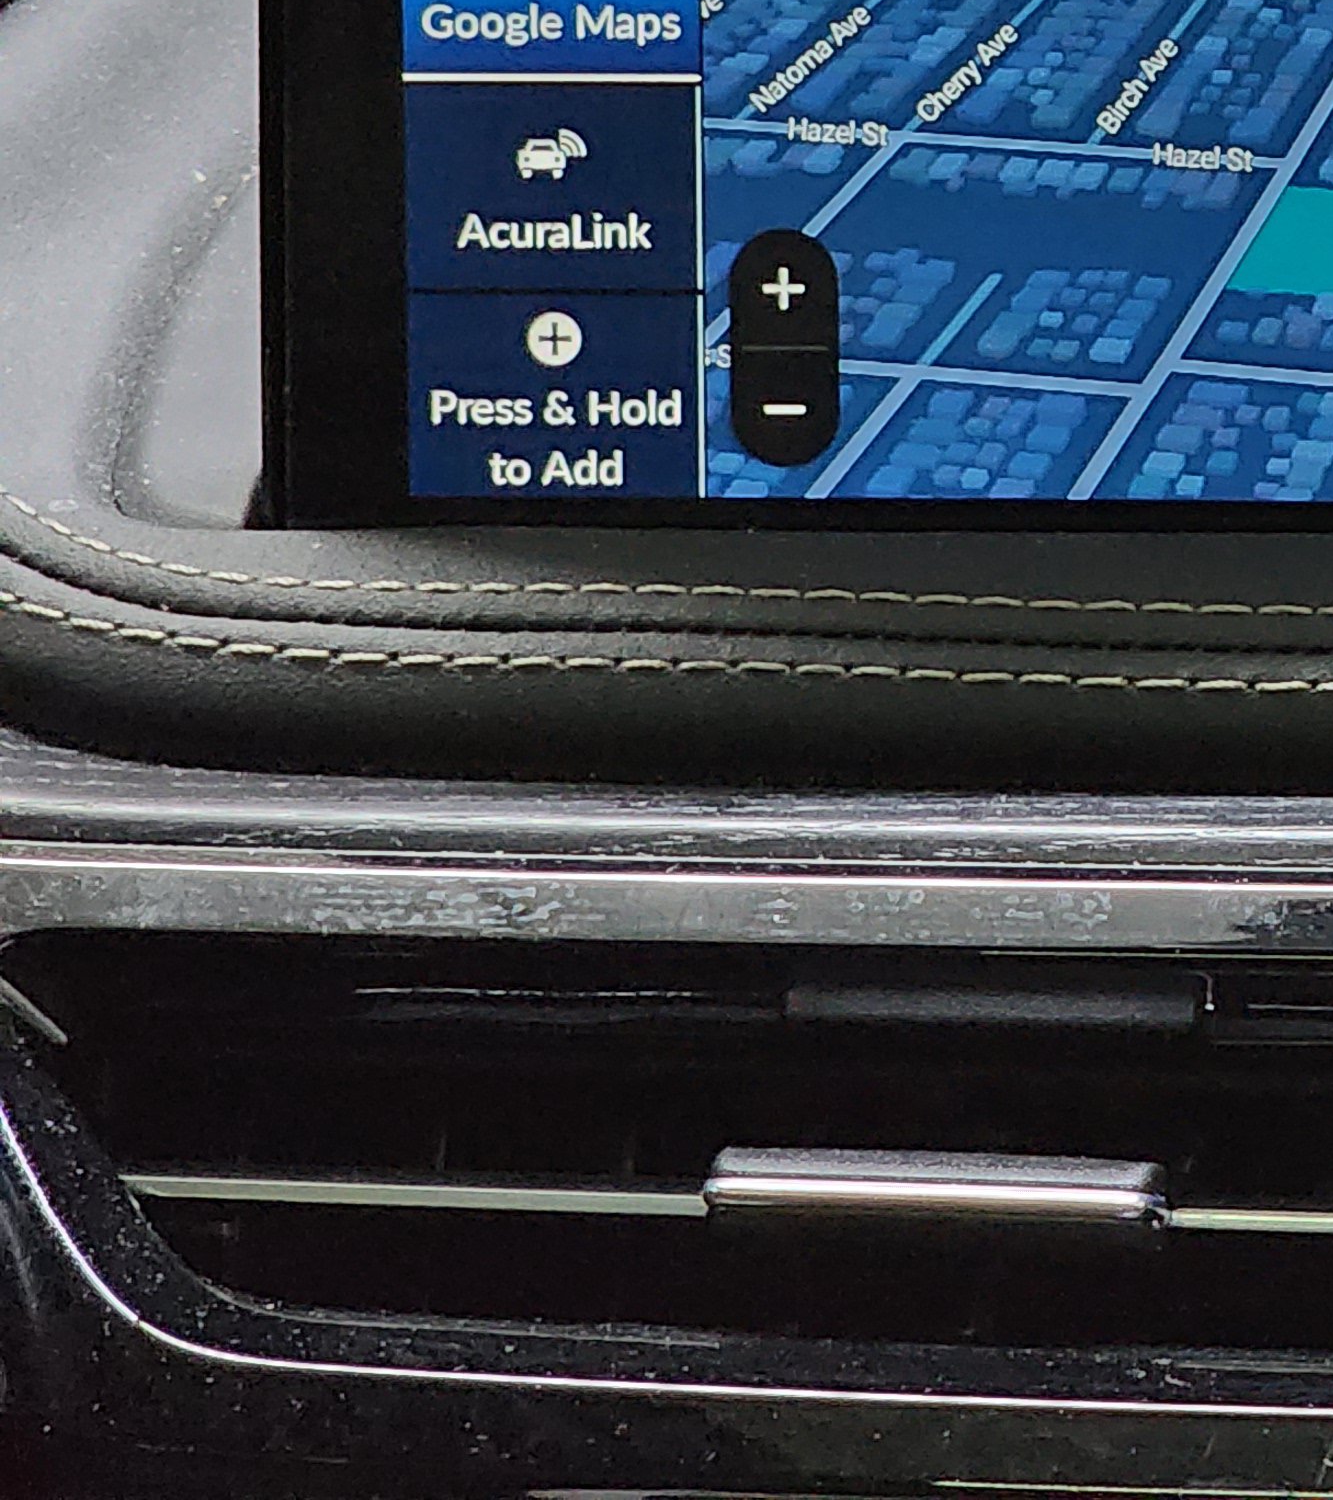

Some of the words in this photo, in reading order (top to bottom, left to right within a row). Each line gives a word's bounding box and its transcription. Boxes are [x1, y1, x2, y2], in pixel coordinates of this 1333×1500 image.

[421, 3, 563, 47] Google
[576, 4, 682, 47] Maps
[974, 22, 1020, 67] Ave
[748, 39, 834, 112] Natoma
[827, 4, 873, 48] Ave
[1096, 78, 1150, 135] Birch
[1138, 37, 1180, 83] Ave
[786, 117, 857, 145] Hazel
[860, 121, 889, 147] St
[1151, 142, 1223, 171] Hazel
[1225, 146, 1254, 173] St
[456, 211, 653, 250] AcuraLink
[429, 389, 534, 427] Press
[542, 390, 577, 426] &
[587, 388, 683, 427] Hold
[488, 454, 531, 487] to
[540, 449, 625, 487] Add
